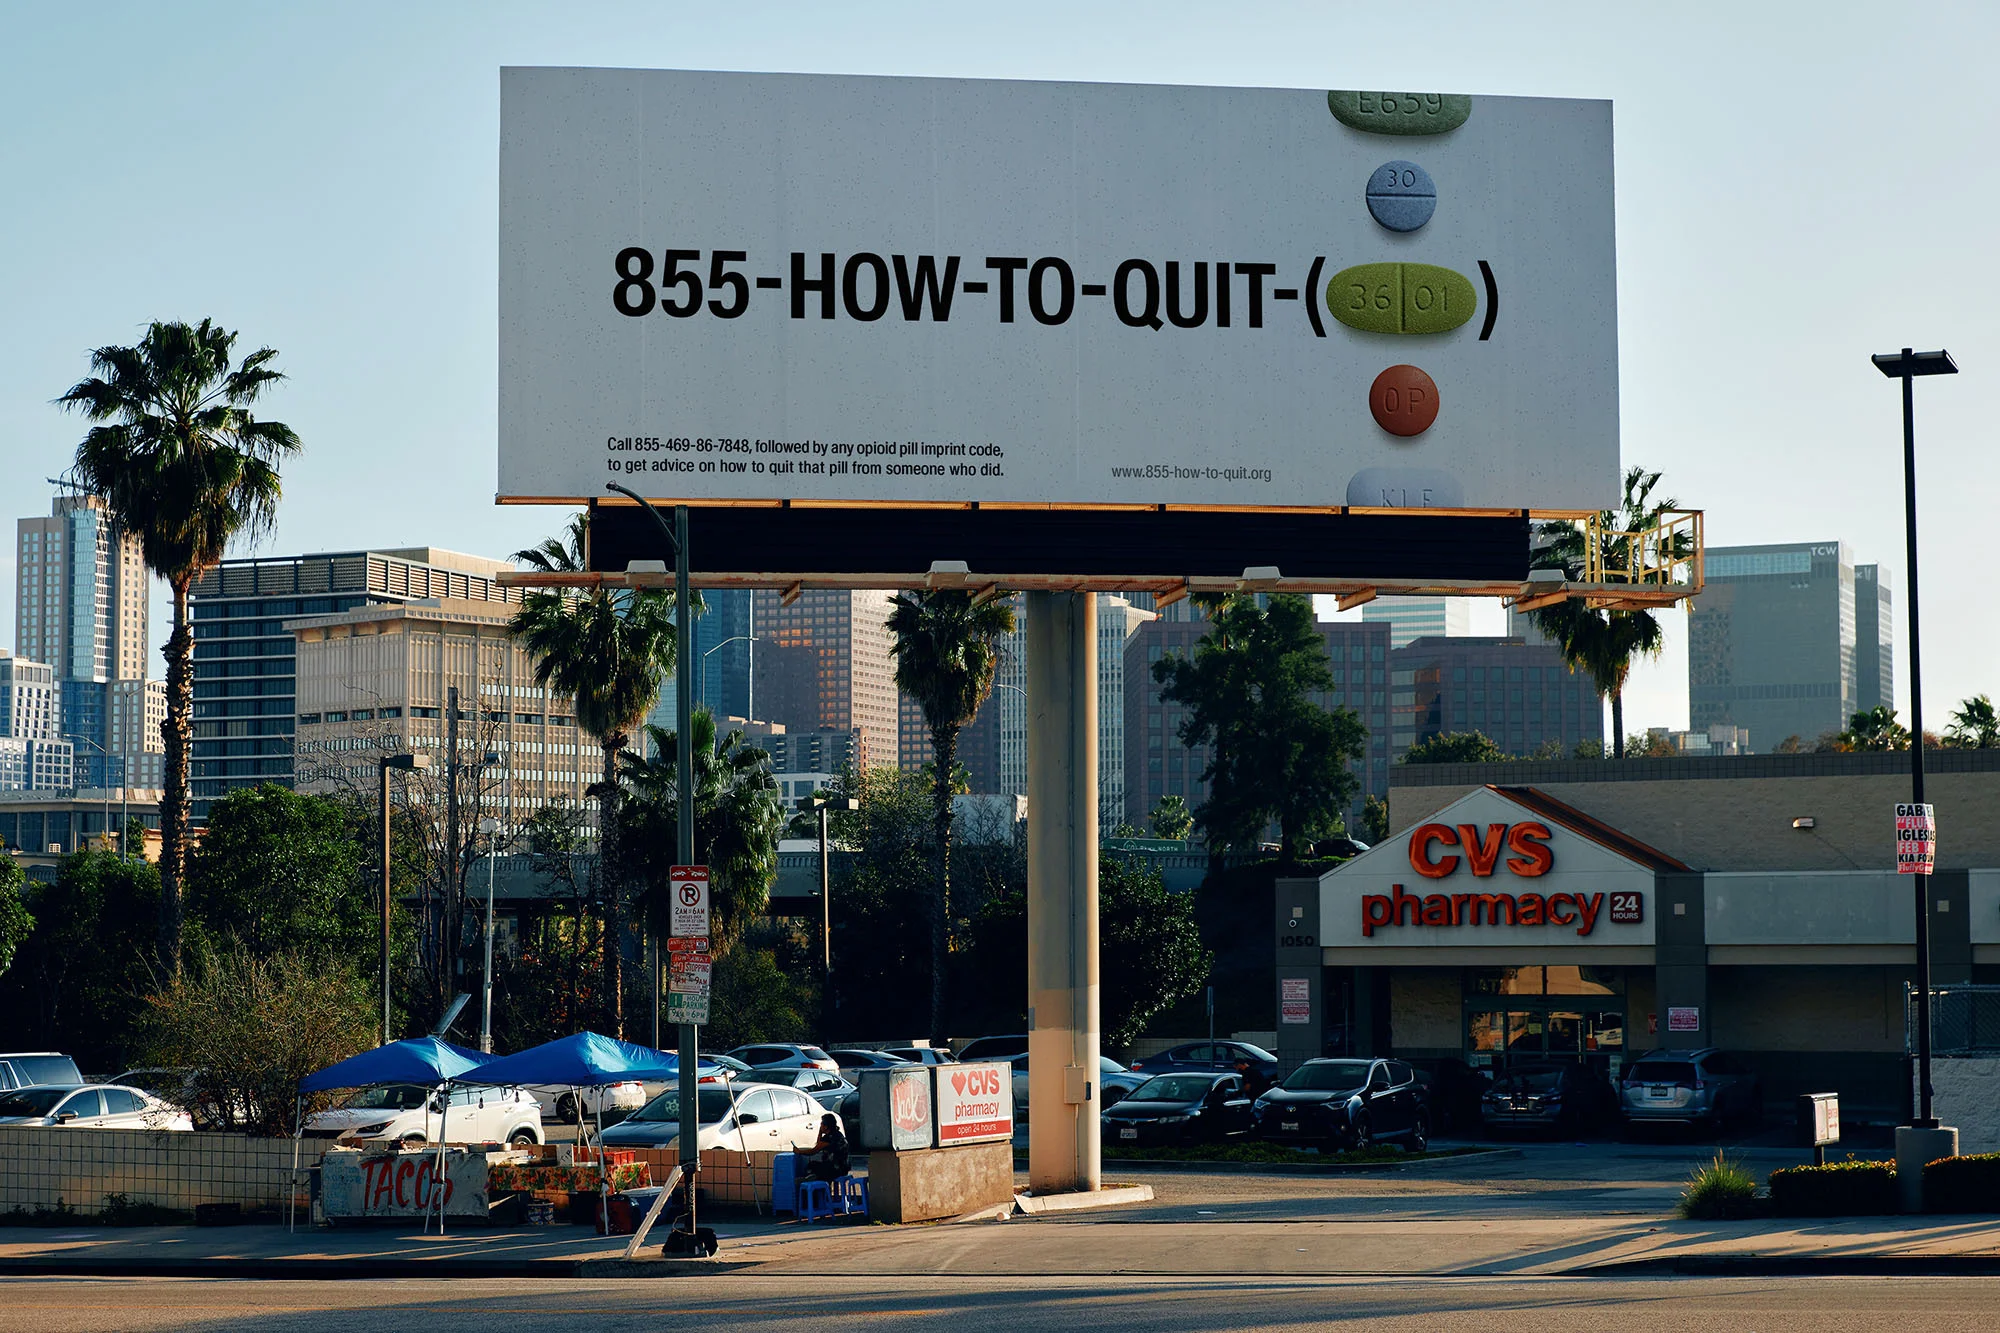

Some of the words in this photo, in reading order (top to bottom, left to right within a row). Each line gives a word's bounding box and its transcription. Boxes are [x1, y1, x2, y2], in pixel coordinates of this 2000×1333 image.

[1387, 169, 1416, 188] 30
[608, 437, 631, 450] Call
[635, 438, 753, 454] 855-469-86-7848,
[755, 440, 809, 453] followed
[813, 441, 828, 456] by
[831, 444, 854, 457] any
[857, 441, 896, 457] opioid
[900, 442, 918, 457] pill
[921, 442, 966, 458] imprint
[969, 443, 1004, 458] code,
[608, 459, 621, 471] to
[625, 459, 647, 474] get
[652, 459, 694, 472] advice
[699, 462, 715, 472] on
[720, 459, 747, 472] how
[752, 461, 764, 473] to
[769, 460, 794, 475] quit
[798, 461, 825, 473] that
[830, 461, 847, 476] pill
[852, 461, 881, 474] from
[886, 464, 945, 475] someone
[949, 463, 976, 476] who
[981, 463, 1004, 476] did.
[1112, 465, 1272, 482] www.855-how-to-quit.org
[1810, 546, 1837, 557] TCW
[1408, 821, 1555, 878] CVS
[1899, 842, 1919, 853] FEB
[1899, 854, 1915, 862] KIA
[1613, 895, 1638, 911] 24
[675, 907, 688, 915] 2AM
[693, 907, 705, 915] 6AM
[1362, 884, 1604, 937] pharmacy
[1612, 912, 1639, 920] HOURS
[1281, 935, 1314, 947] 1050
[685, 963, 710, 973] STOPPING
[694, 976, 708, 985] 9AM
[683, 1001, 708, 1010] PARKING
[691, 1010, 705, 1019] 6PM
[968, 1069, 1000, 1097] CVS
[895, 1083, 927, 1125] Jack
[955, 1101, 1000, 1120] pharmacy
[957, 1125, 972, 1135] open
[973, 1124, 980, 1132] 24
[981, 1123, 997, 1132] hours
[560, 1149, 572, 1162] TIP
[360, 1157, 454, 1211] TACOS
